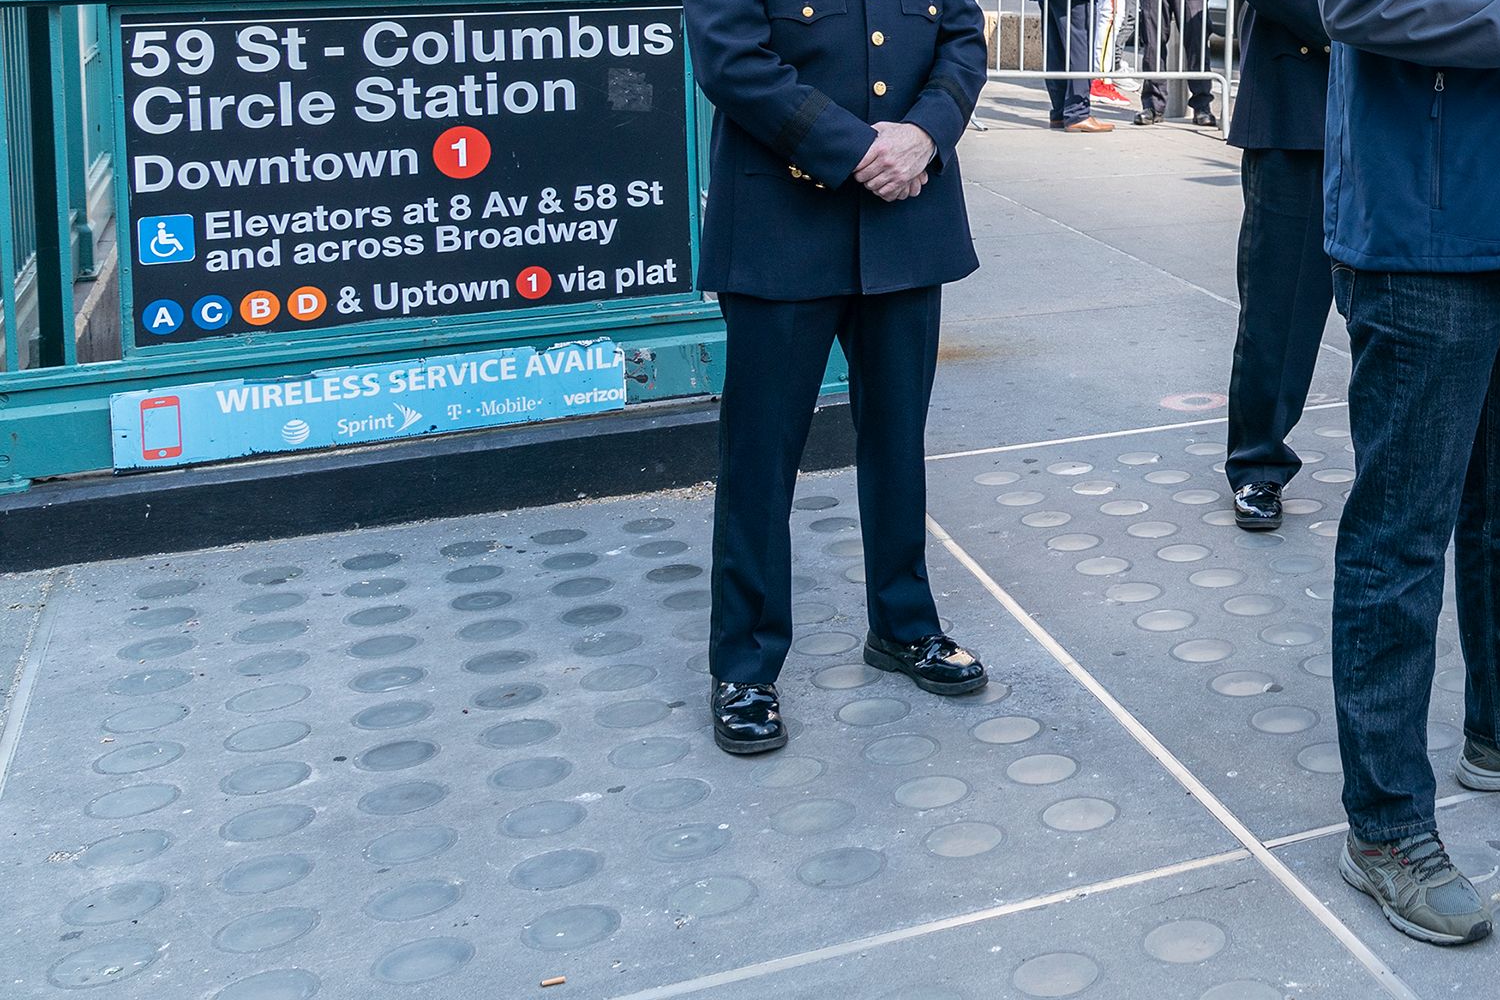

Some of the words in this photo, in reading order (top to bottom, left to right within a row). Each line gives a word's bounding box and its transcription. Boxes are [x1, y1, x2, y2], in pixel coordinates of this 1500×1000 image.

[130, 29, 215, 77] 59
[236, 25, 308, 73] St
[324, 46, 345, 57] -
[363, 16, 675, 68] Columbus
[132, 81, 336, 135] Circle
[355, 72, 576, 123] Station
[134, 148, 419, 194] Downtown
[450, 138, 468, 167] 1
[205, 203, 392, 240] Elevators
[403, 197, 440, 225] at
[450, 194, 472, 221] 8
[482, 191, 528, 219] Av
[538, 187, 564, 214] &
[573, 183, 617, 212] 58
[626, 180, 664, 208] St
[205, 239, 281, 273] and
[293, 234, 425, 265] across
[436, 218, 618, 253] Broadway
[152, 306, 175, 328] A
[201, 302, 223, 324] C
[251, 297, 271, 319] B
[297, 293, 318, 315] D
[336, 285, 364, 315] &
[373, 276, 510, 315] Uptown
[527, 273, 538, 293] 1
[558, 265, 606, 293] via
[615, 258, 677, 293] plat
[216, 372, 381, 414] WIRELESS
[389, 357, 517, 394] SERVICE
[337, 412, 395, 437] Sprint
